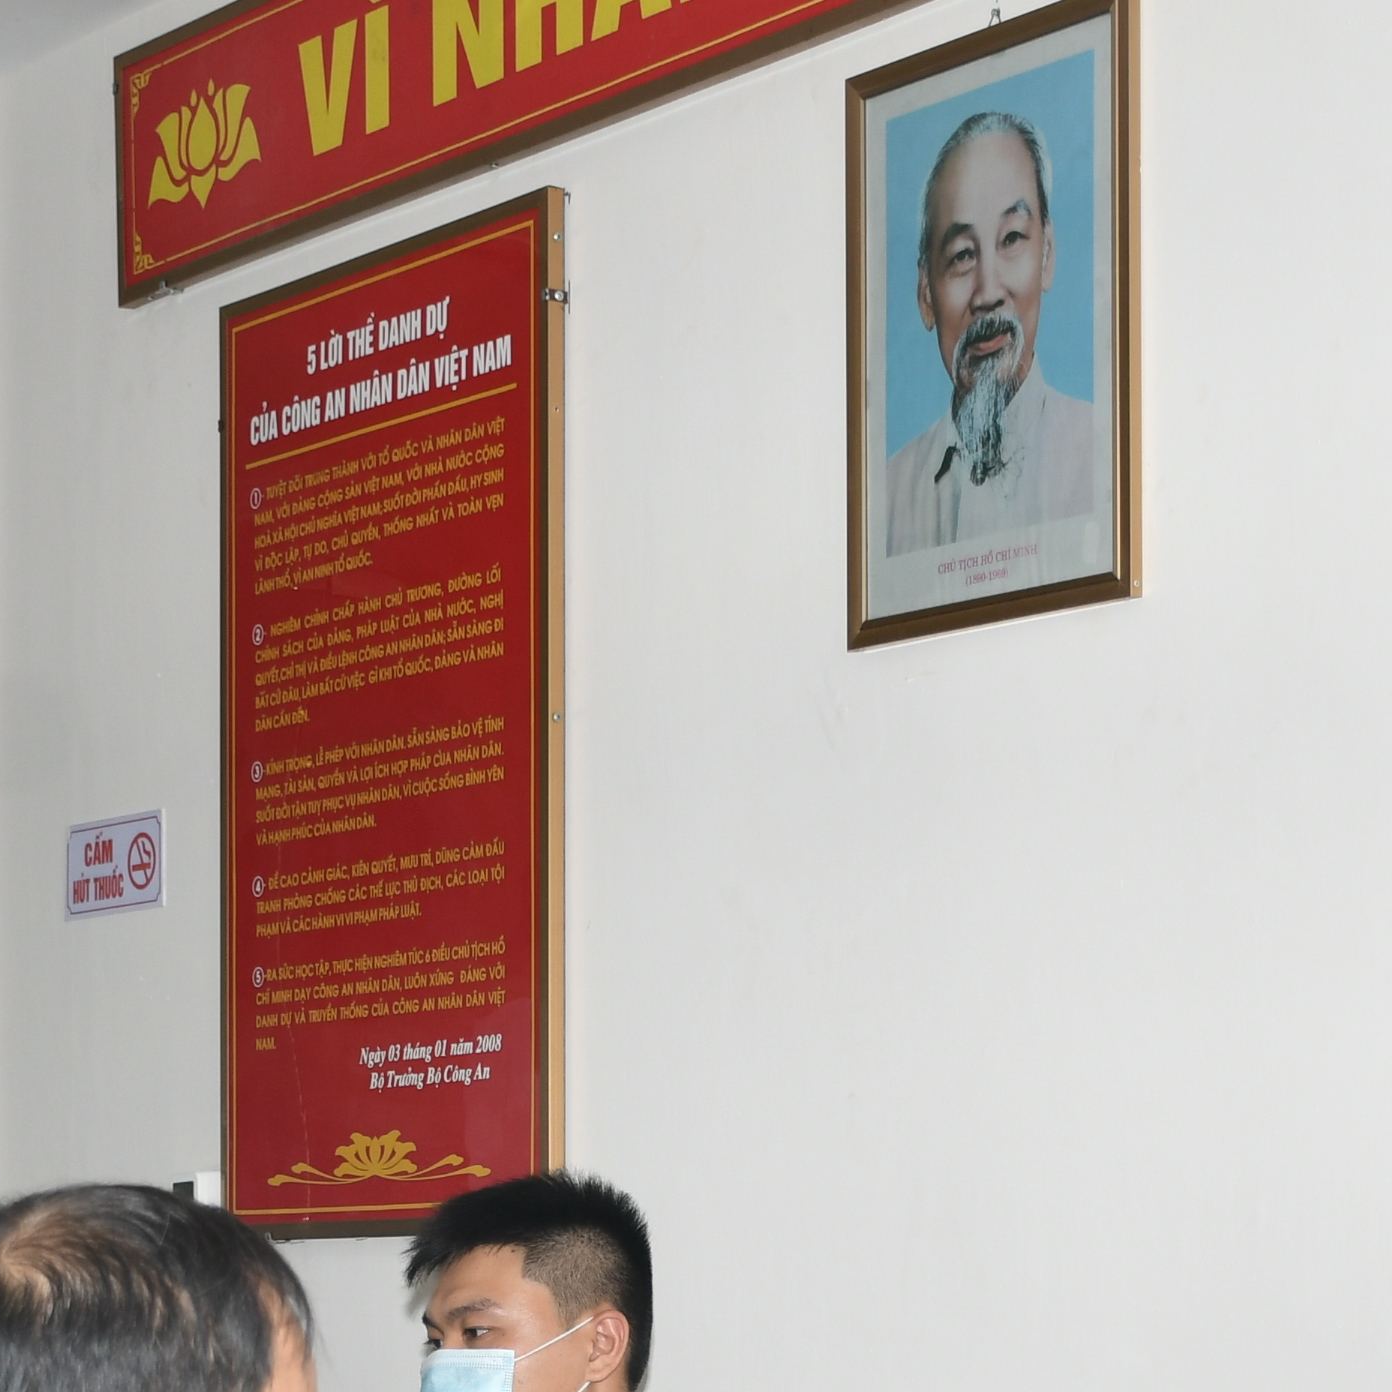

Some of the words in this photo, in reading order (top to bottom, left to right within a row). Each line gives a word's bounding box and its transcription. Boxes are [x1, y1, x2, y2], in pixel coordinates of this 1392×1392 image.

[307, 344, 317, 375] 5
[320, 329, 343, 371] LỜI
[346, 312, 375, 361] THỀ
[378, 308, 422, 351] DANH
[426, 295, 450, 340] DỰ
[250, 401, 278, 446] CỦA
[281, 395, 321, 436] CÔNG
[324, 387, 346, 422] AN
[349, 369, 393, 415] NHÂN
[396, 357, 430, 400] DÂN
[434, 344, 469, 391] VIỆT
[472, 334, 512, 377] NAM
[84, 831, 113, 867] CẤM
[73, 872, 90, 904] HÚT
[94, 865, 124, 901] THUỐC
[255, 1013, 279, 1029] DANH
[293, 1006, 307, 1025] VÀ
[339, 1000, 370, 1020] THỐNG
[371, 997, 390, 1017] CỦA
[391, 996, 420, 1015] CÔNG
[421, 997, 436, 1012] AN
[437, 991, 463, 1011] NHÂN
[465, 989, 486, 1008] DÂN
[487, 985, 506, 1008] VIỆT
[359, 1046, 387, 1069] Ngày
[387, 1043, 401, 1062] 03
[402, 1042, 433, 1063] tháng
[434, 1039, 447, 1058] 01
[449, 1038, 474, 1056] năm
[475, 1033, 503, 1054] 2008
[369, 1072, 385, 1093] Bộ
[386, 1066, 425, 1090] Trưởng
[426, 1066, 442, 1088] Bộ
[443, 1064, 473, 1086] Công
[473, 1062, 491, 1081] An
